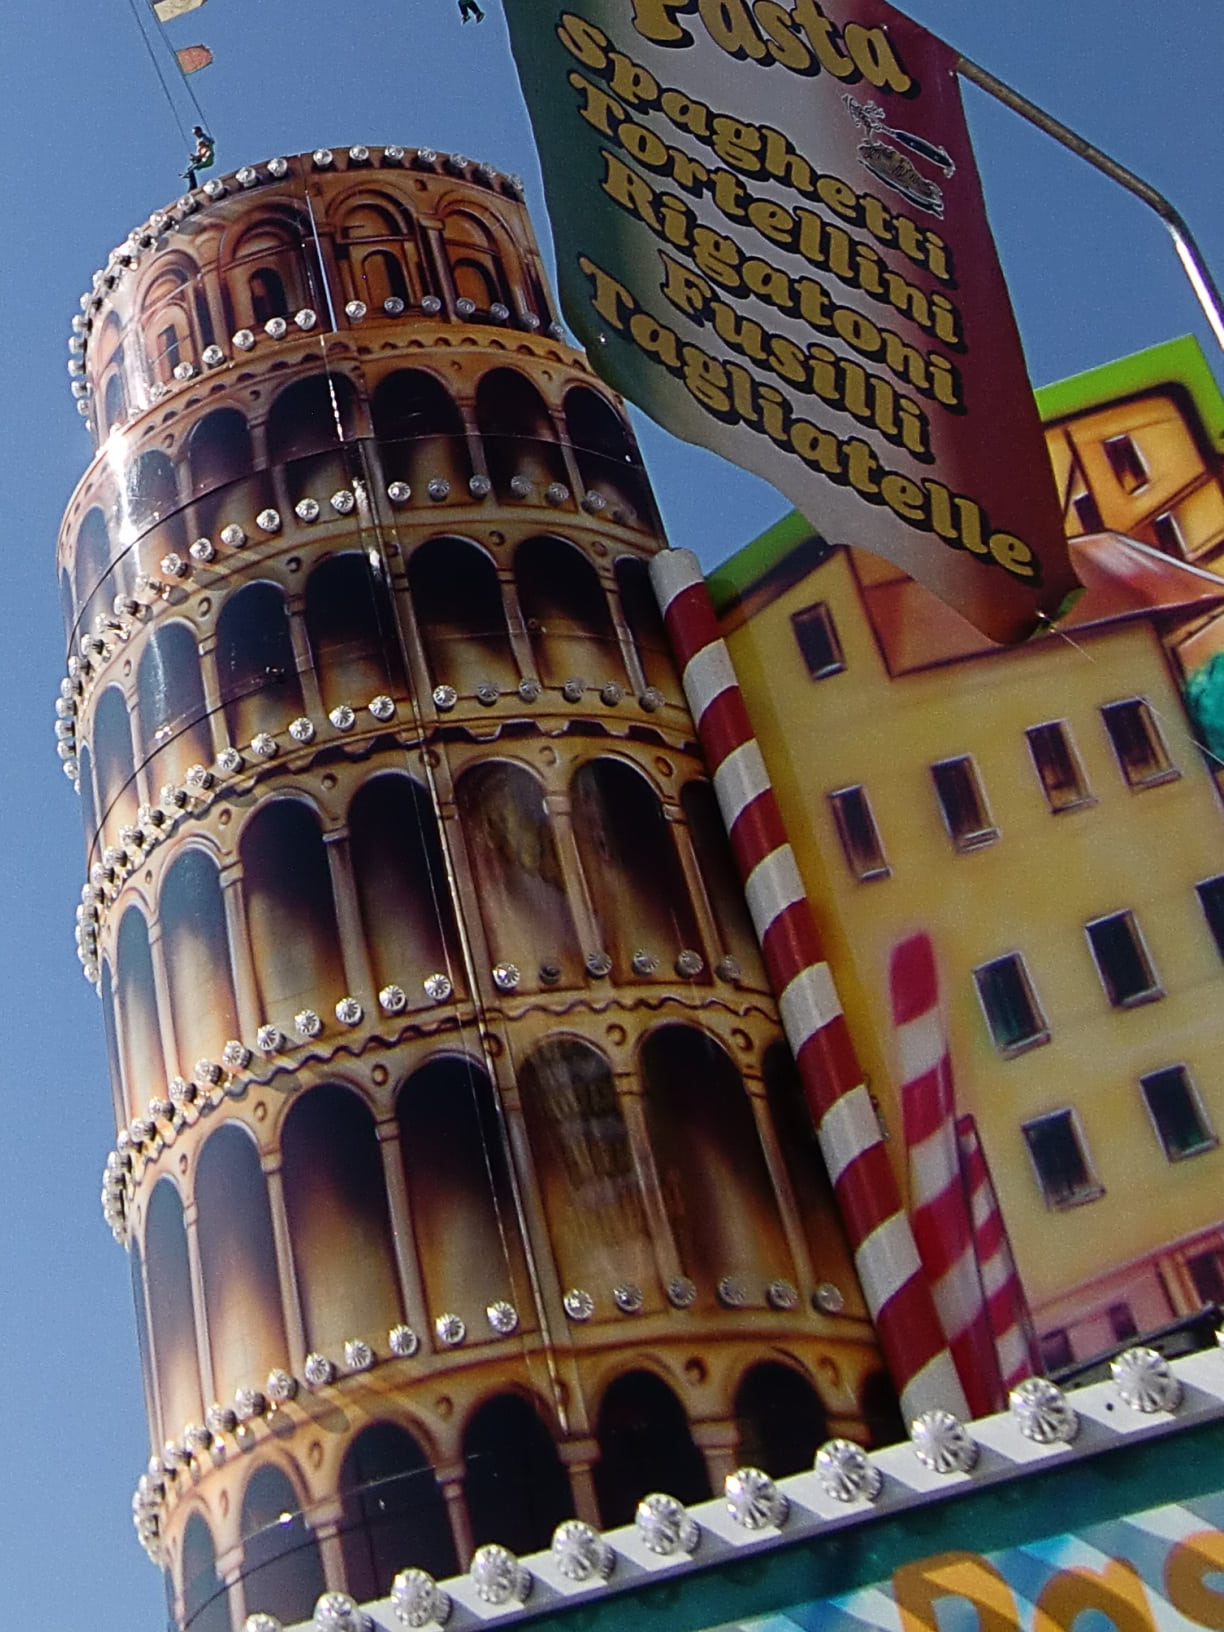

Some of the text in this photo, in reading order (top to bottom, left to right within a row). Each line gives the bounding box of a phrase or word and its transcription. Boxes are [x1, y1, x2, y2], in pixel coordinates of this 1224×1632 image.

[555, 11, 956, 289] Spaghetti
[568, 70, 966, 352] Tortellini
[601, 148, 966, 414] Rigatoni
[577, 252, 1043, 587] Tagliatelle
[658, 249, 935, 464] Fusilli
